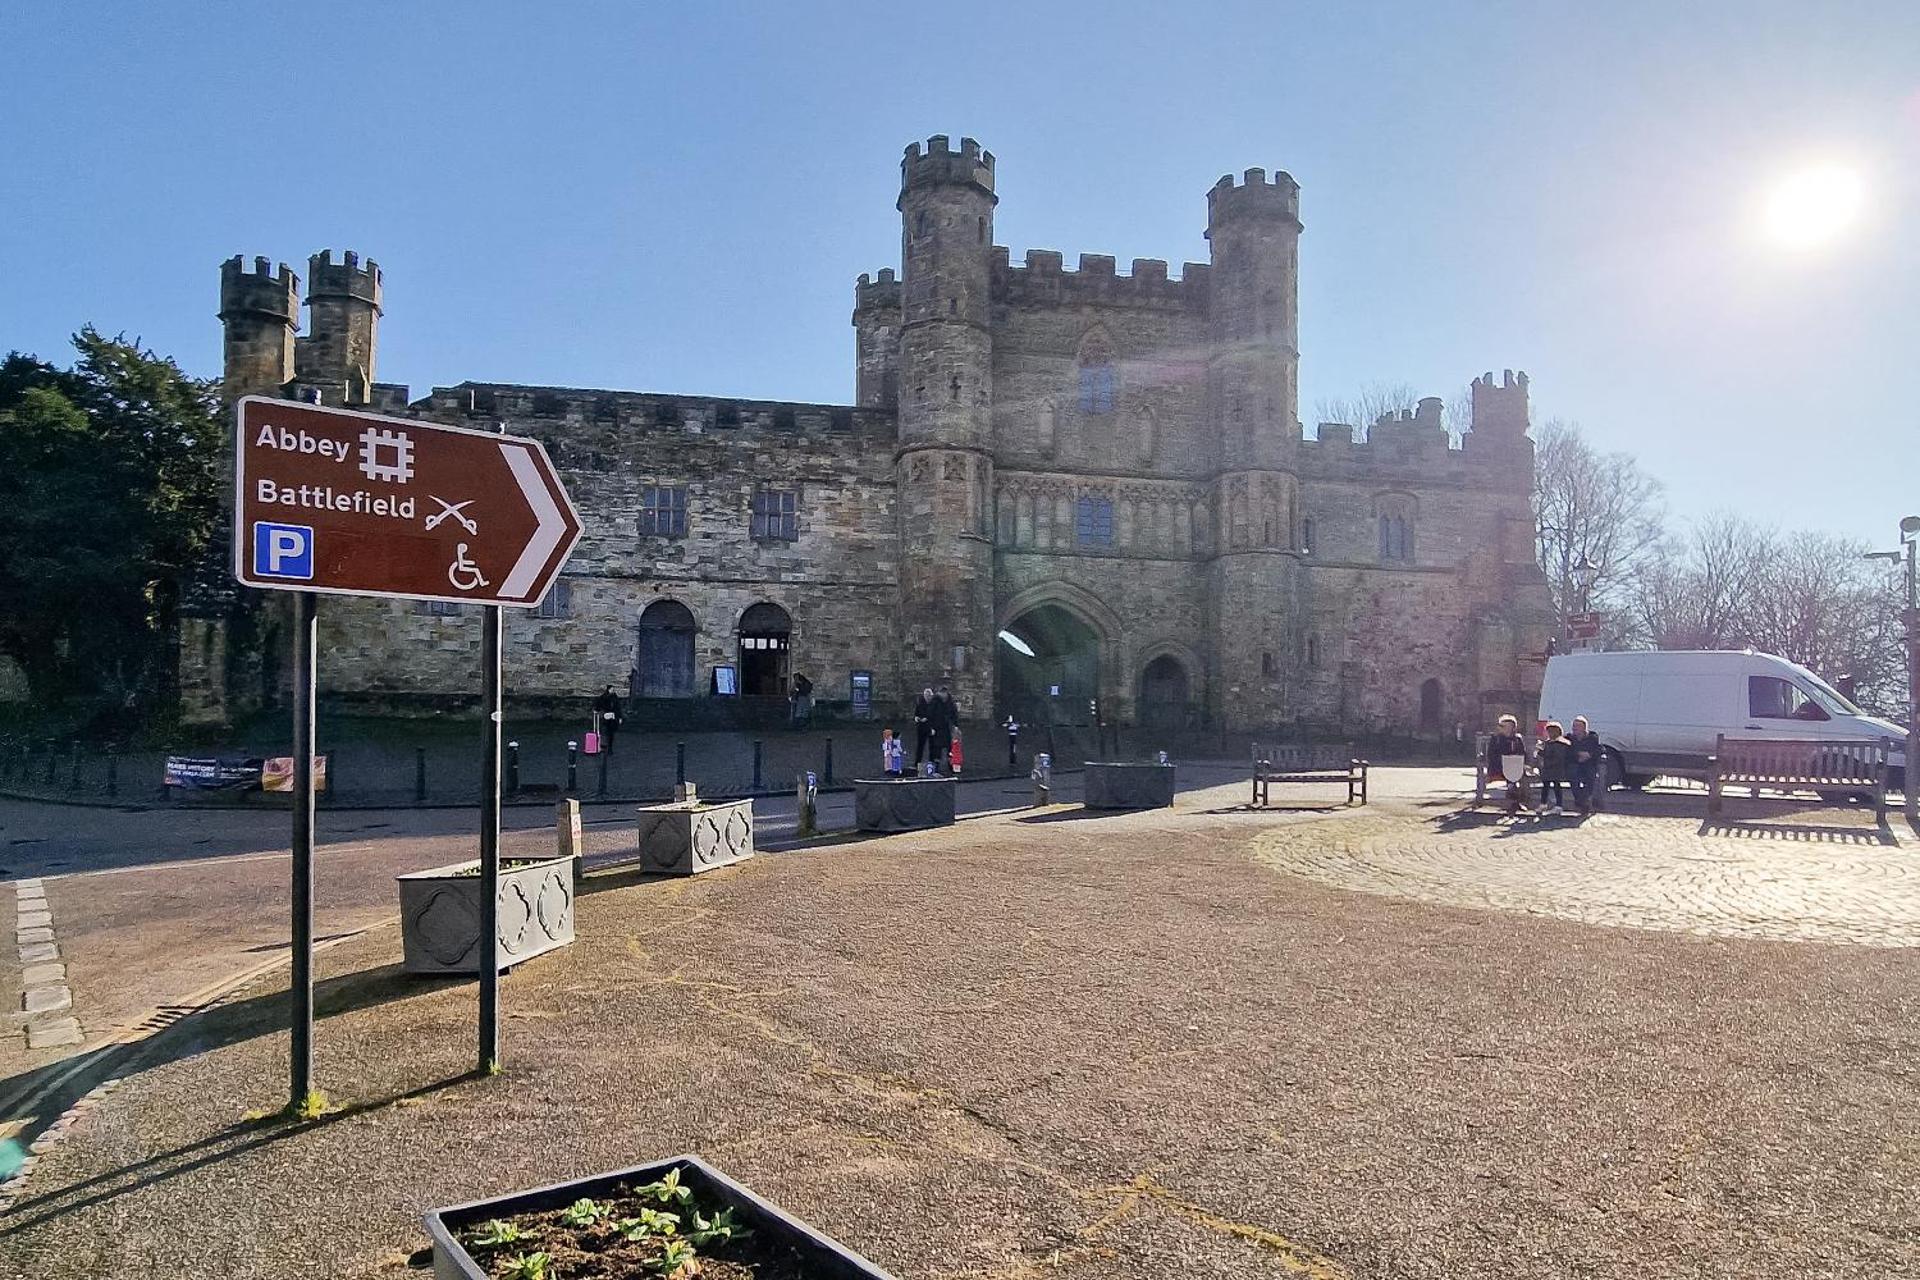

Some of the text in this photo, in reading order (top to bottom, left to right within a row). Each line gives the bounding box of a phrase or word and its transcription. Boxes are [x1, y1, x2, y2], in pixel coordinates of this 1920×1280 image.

[256, 424, 350, 463] Abbey
[257, 479, 415, 519] Battlefield
[269, 529, 305, 572] P
